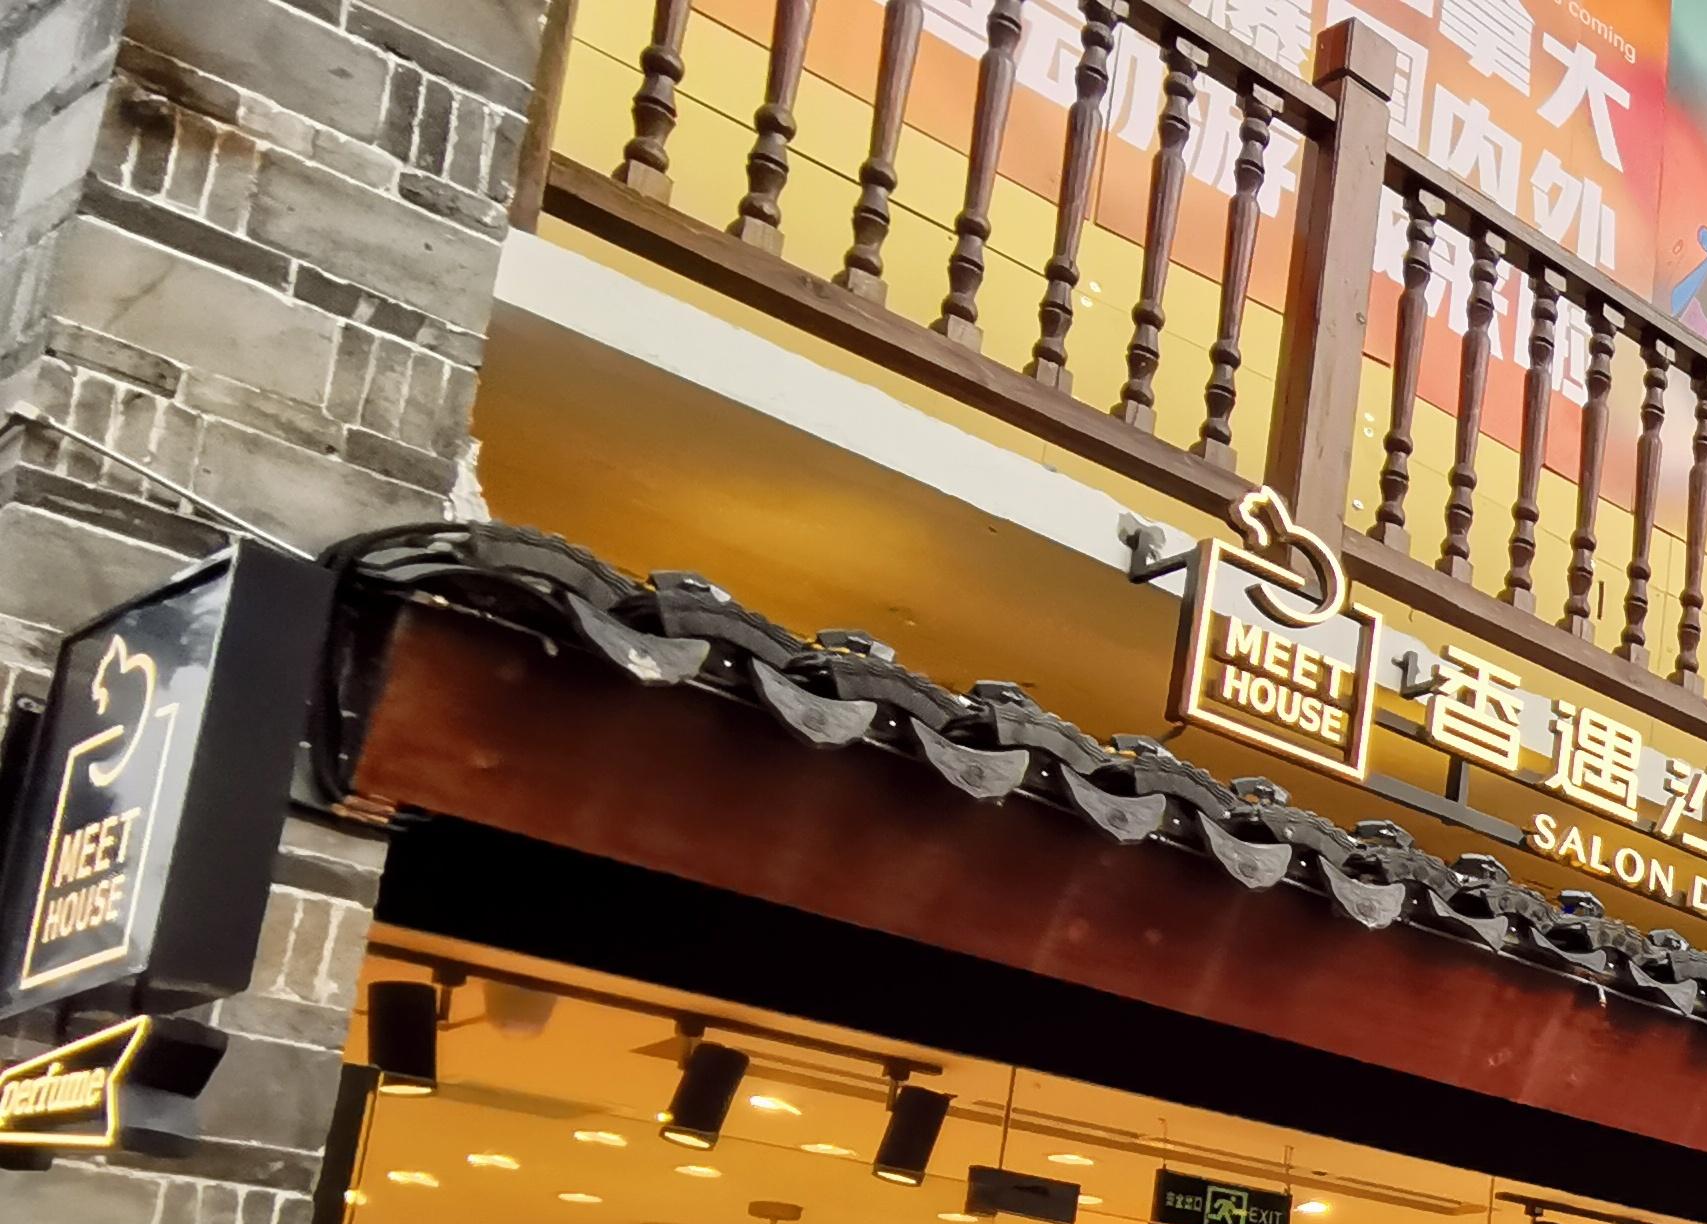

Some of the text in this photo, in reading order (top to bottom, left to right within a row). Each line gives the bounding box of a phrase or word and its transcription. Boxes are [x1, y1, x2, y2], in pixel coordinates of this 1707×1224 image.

[1568, 1, 1637, 64] coming
[1222, 620, 1354, 741] MEET HOUSE
[41, 806, 142, 944] MEET HOUSE
[1529, 811, 1675, 902] SALON
[0, 1061, 107, 1126] perfume
